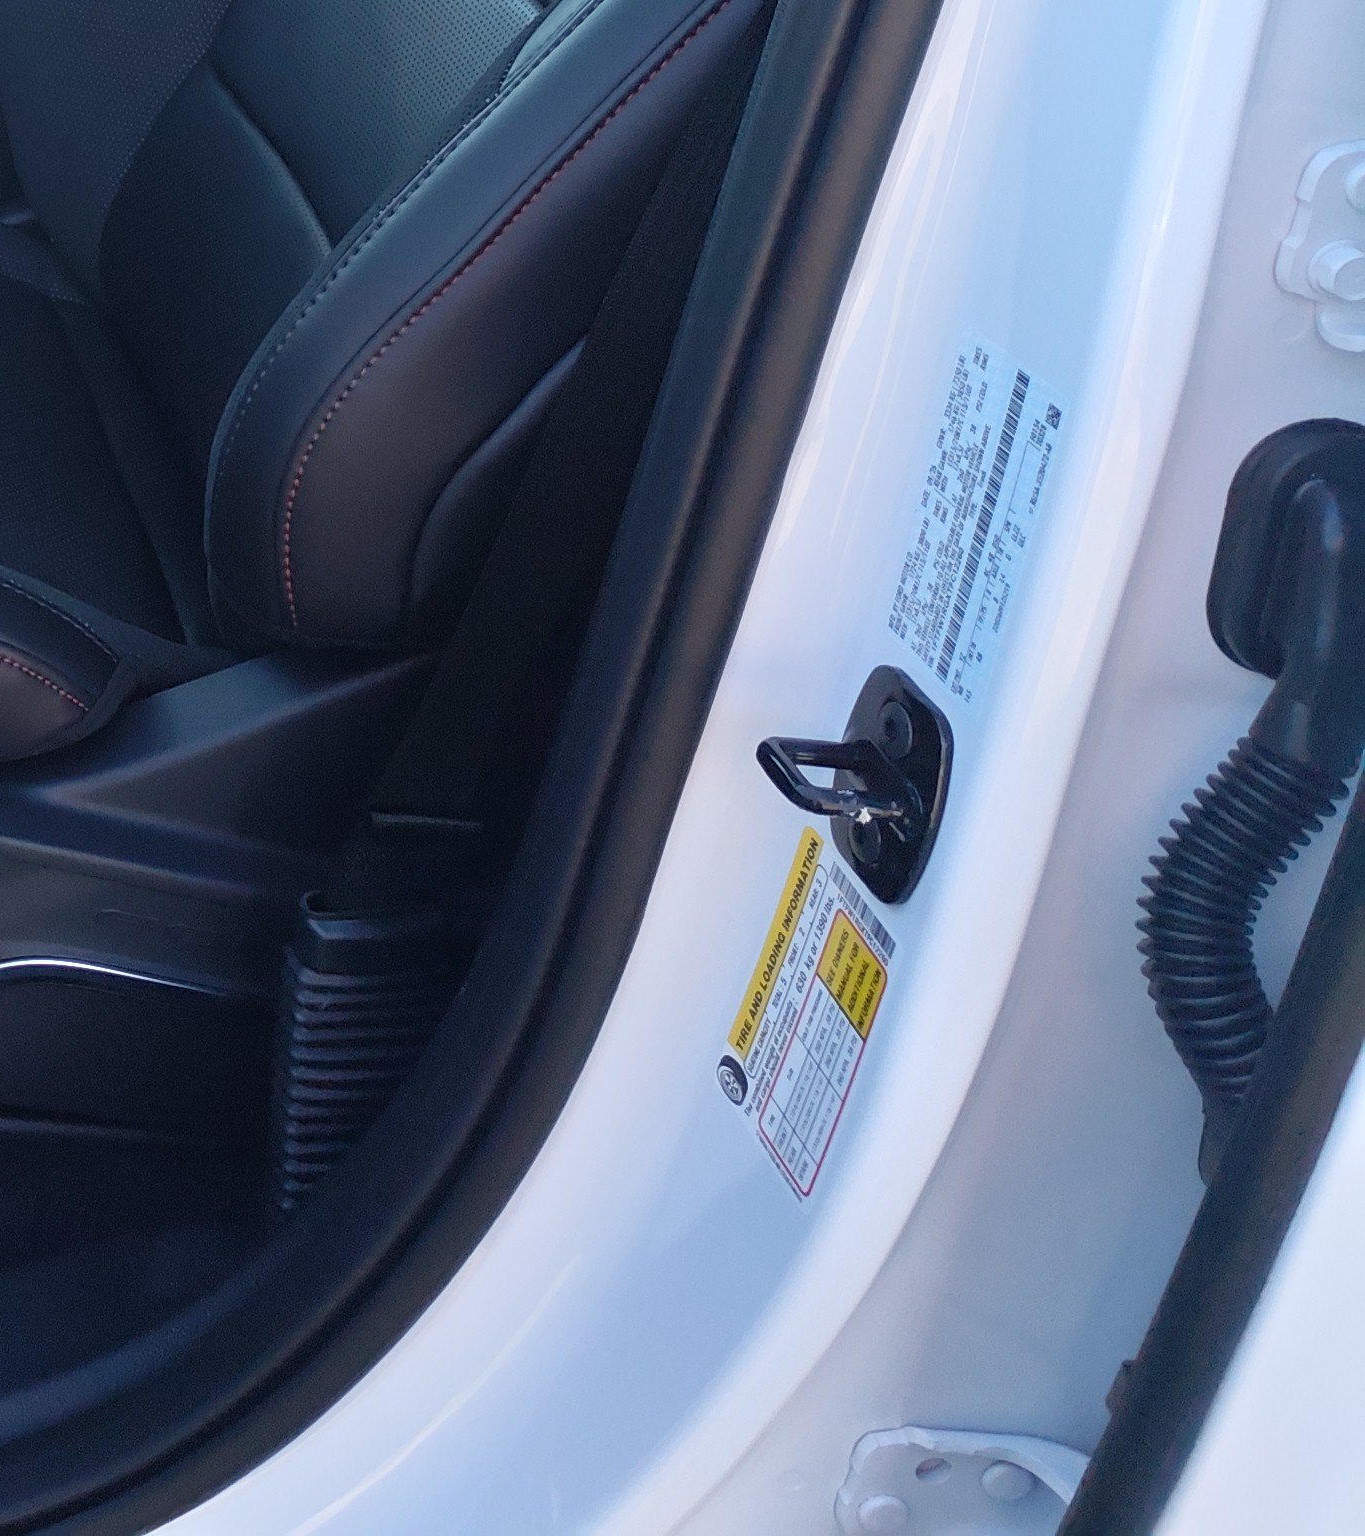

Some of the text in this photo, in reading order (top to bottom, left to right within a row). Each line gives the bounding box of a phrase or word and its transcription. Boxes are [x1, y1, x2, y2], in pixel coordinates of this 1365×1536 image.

[894, 583, 903, 604] FORD
[735, 834, 818, 1055] TIRE AND LOADING INFORMATION
[795, 967, 807, 995] 630
[803, 950, 814, 973] kg
[813, 909, 828, 943] 1390
[825, 926, 849, 987] SEE OWNERS
[835, 939, 859, 1003] MANUAL FOR
[846, 956, 869, 1013] ADDITIONAL
[856, 966, 882, 1031] INFORMATION
